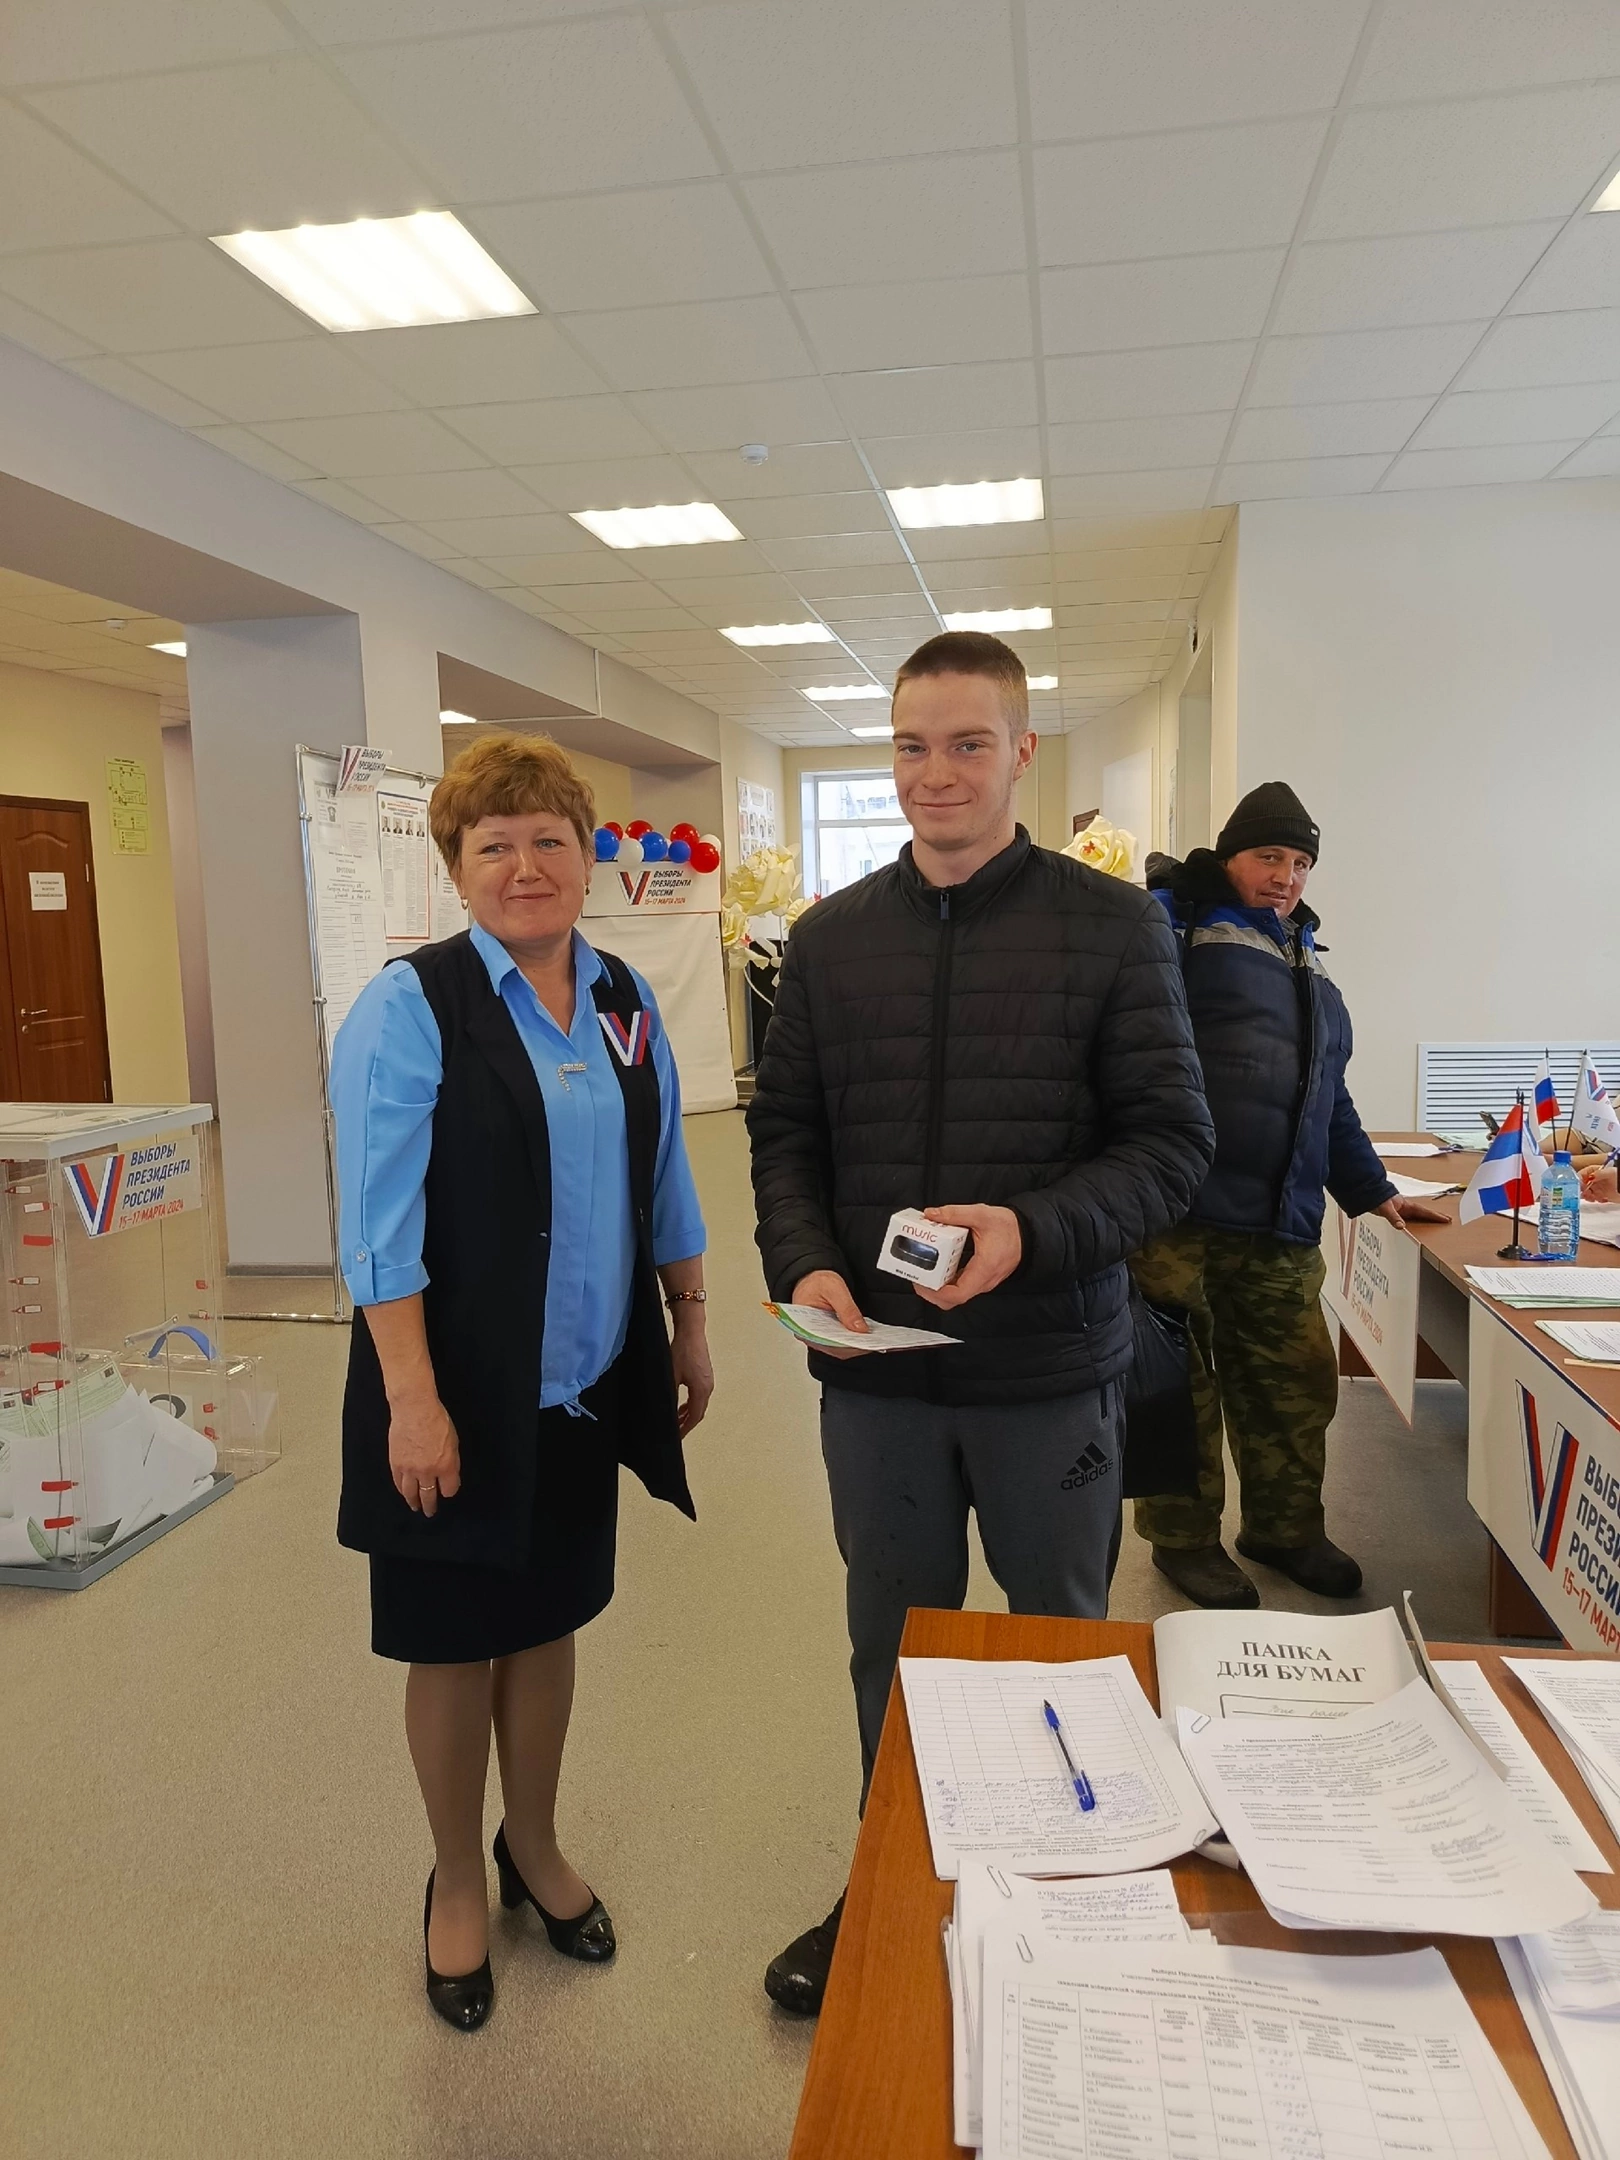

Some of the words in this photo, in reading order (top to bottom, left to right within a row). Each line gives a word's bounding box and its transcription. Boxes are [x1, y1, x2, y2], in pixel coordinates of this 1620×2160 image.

[650, 879, 692, 888] ПРЕЗИДЕНТА
[653, 870, 684, 879] ВЫБОРЫ
[646, 889, 674, 897] РОССИИ
[130, 1143, 177, 1167] ВЫБОРЫ
[126, 1159, 191, 1188] ПРЕЗИДЕНТА
[122, 1185, 165, 1210] РОССИИ
[141, 1204, 166, 1220] МАРТА
[167, 1199, 184, 1214] 2024
[902, 1224, 938, 1243] music
[1359, 1220, 1382, 1259] ВЫБОРЫ
[1356, 1246, 1389, 1299] ПРЕЗИДЕНТА
[1354, 1270, 1374, 1308] РОССИИ
[1061, 1458, 1113, 1490] adidas
[1584, 1455, 1620, 1519] ВЫБ
[1568, 1531, 1620, 1616] РОССИ
[1241, 1642, 1333, 1661] ПАПКА
[1217, 1661, 1270, 1679] ДЛЯ
[1273, 1664, 1367, 1683] БУМАГ
